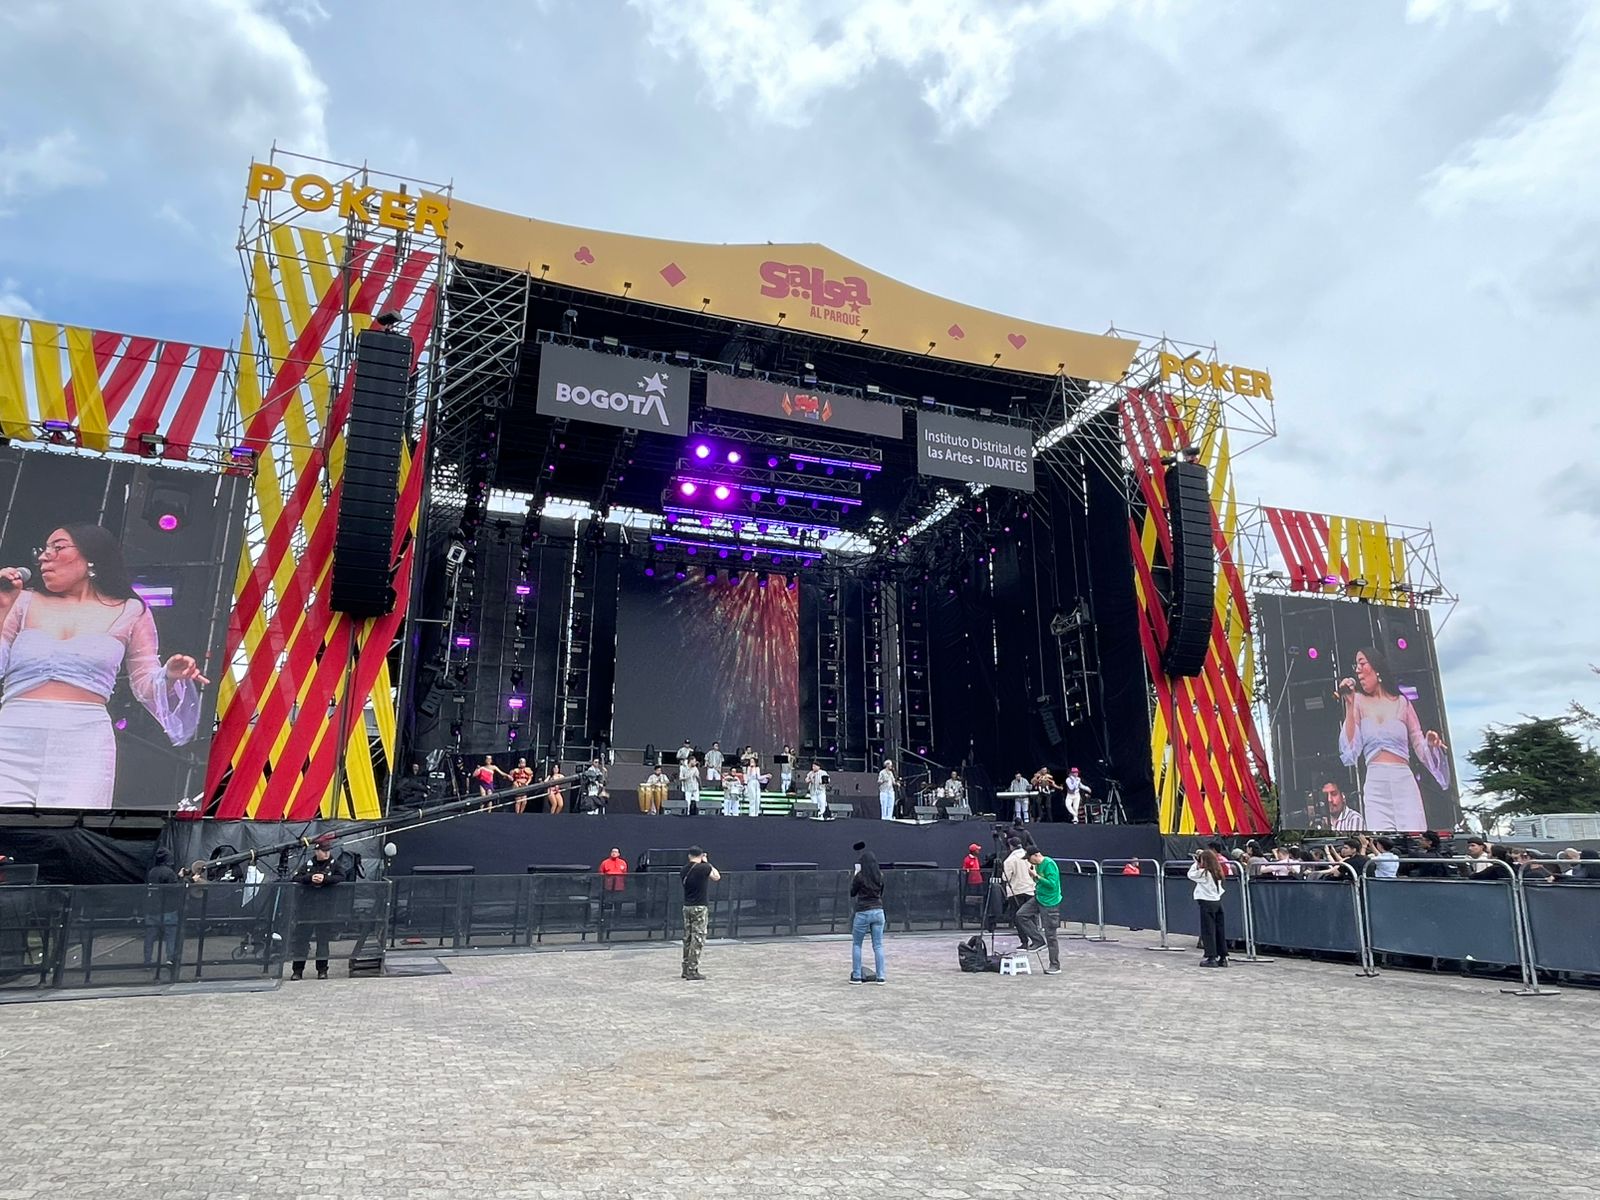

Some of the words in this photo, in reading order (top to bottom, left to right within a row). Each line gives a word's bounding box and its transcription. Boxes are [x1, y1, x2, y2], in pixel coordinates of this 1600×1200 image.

[248, 162, 450, 239] POKER
[759, 261, 871, 308] Salsa
[810, 306, 823, 319] AL
[824, 308, 861, 326] PARQUE
[1160, 352, 1274, 401] POKER
[924, 428, 969, 448] Instituto
[971, 437, 1011, 456] Distrital
[1013, 444, 1027, 458] de
[927, 445, 943, 460] las
[945, 448, 973, 465] Artes
[983, 454, 1028, 473] IDARTES
